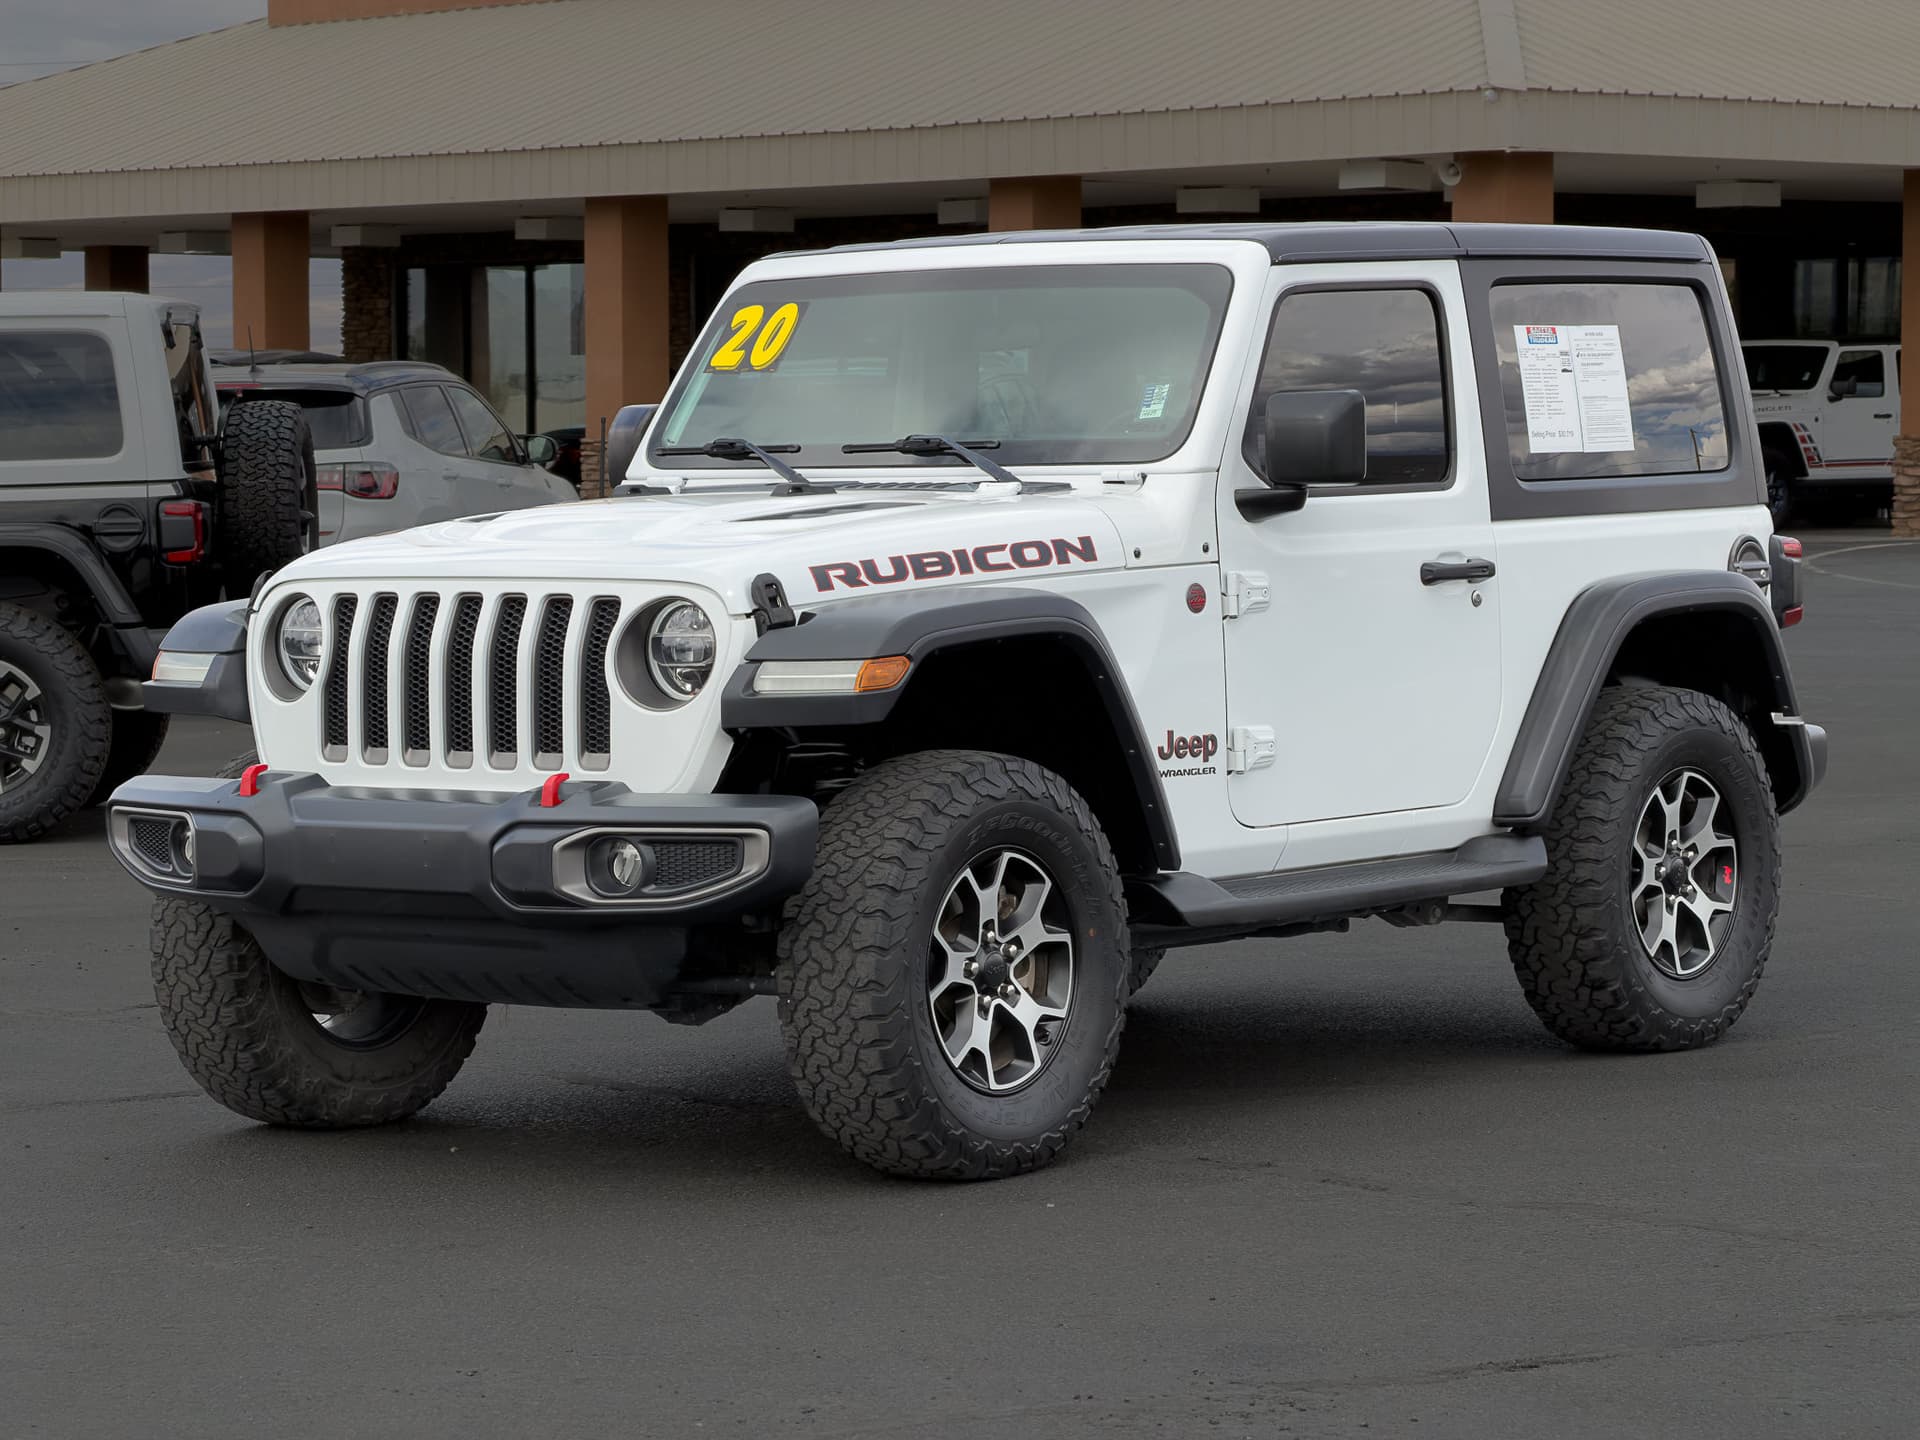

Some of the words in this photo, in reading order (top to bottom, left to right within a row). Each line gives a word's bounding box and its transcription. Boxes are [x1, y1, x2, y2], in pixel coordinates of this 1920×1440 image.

[710, 302, 799, 371] 20
[808, 535, 1098, 592] RUBICON
[1157, 729, 1218, 763] Jeep
[1159, 766, 1217, 778] WRANGLER
